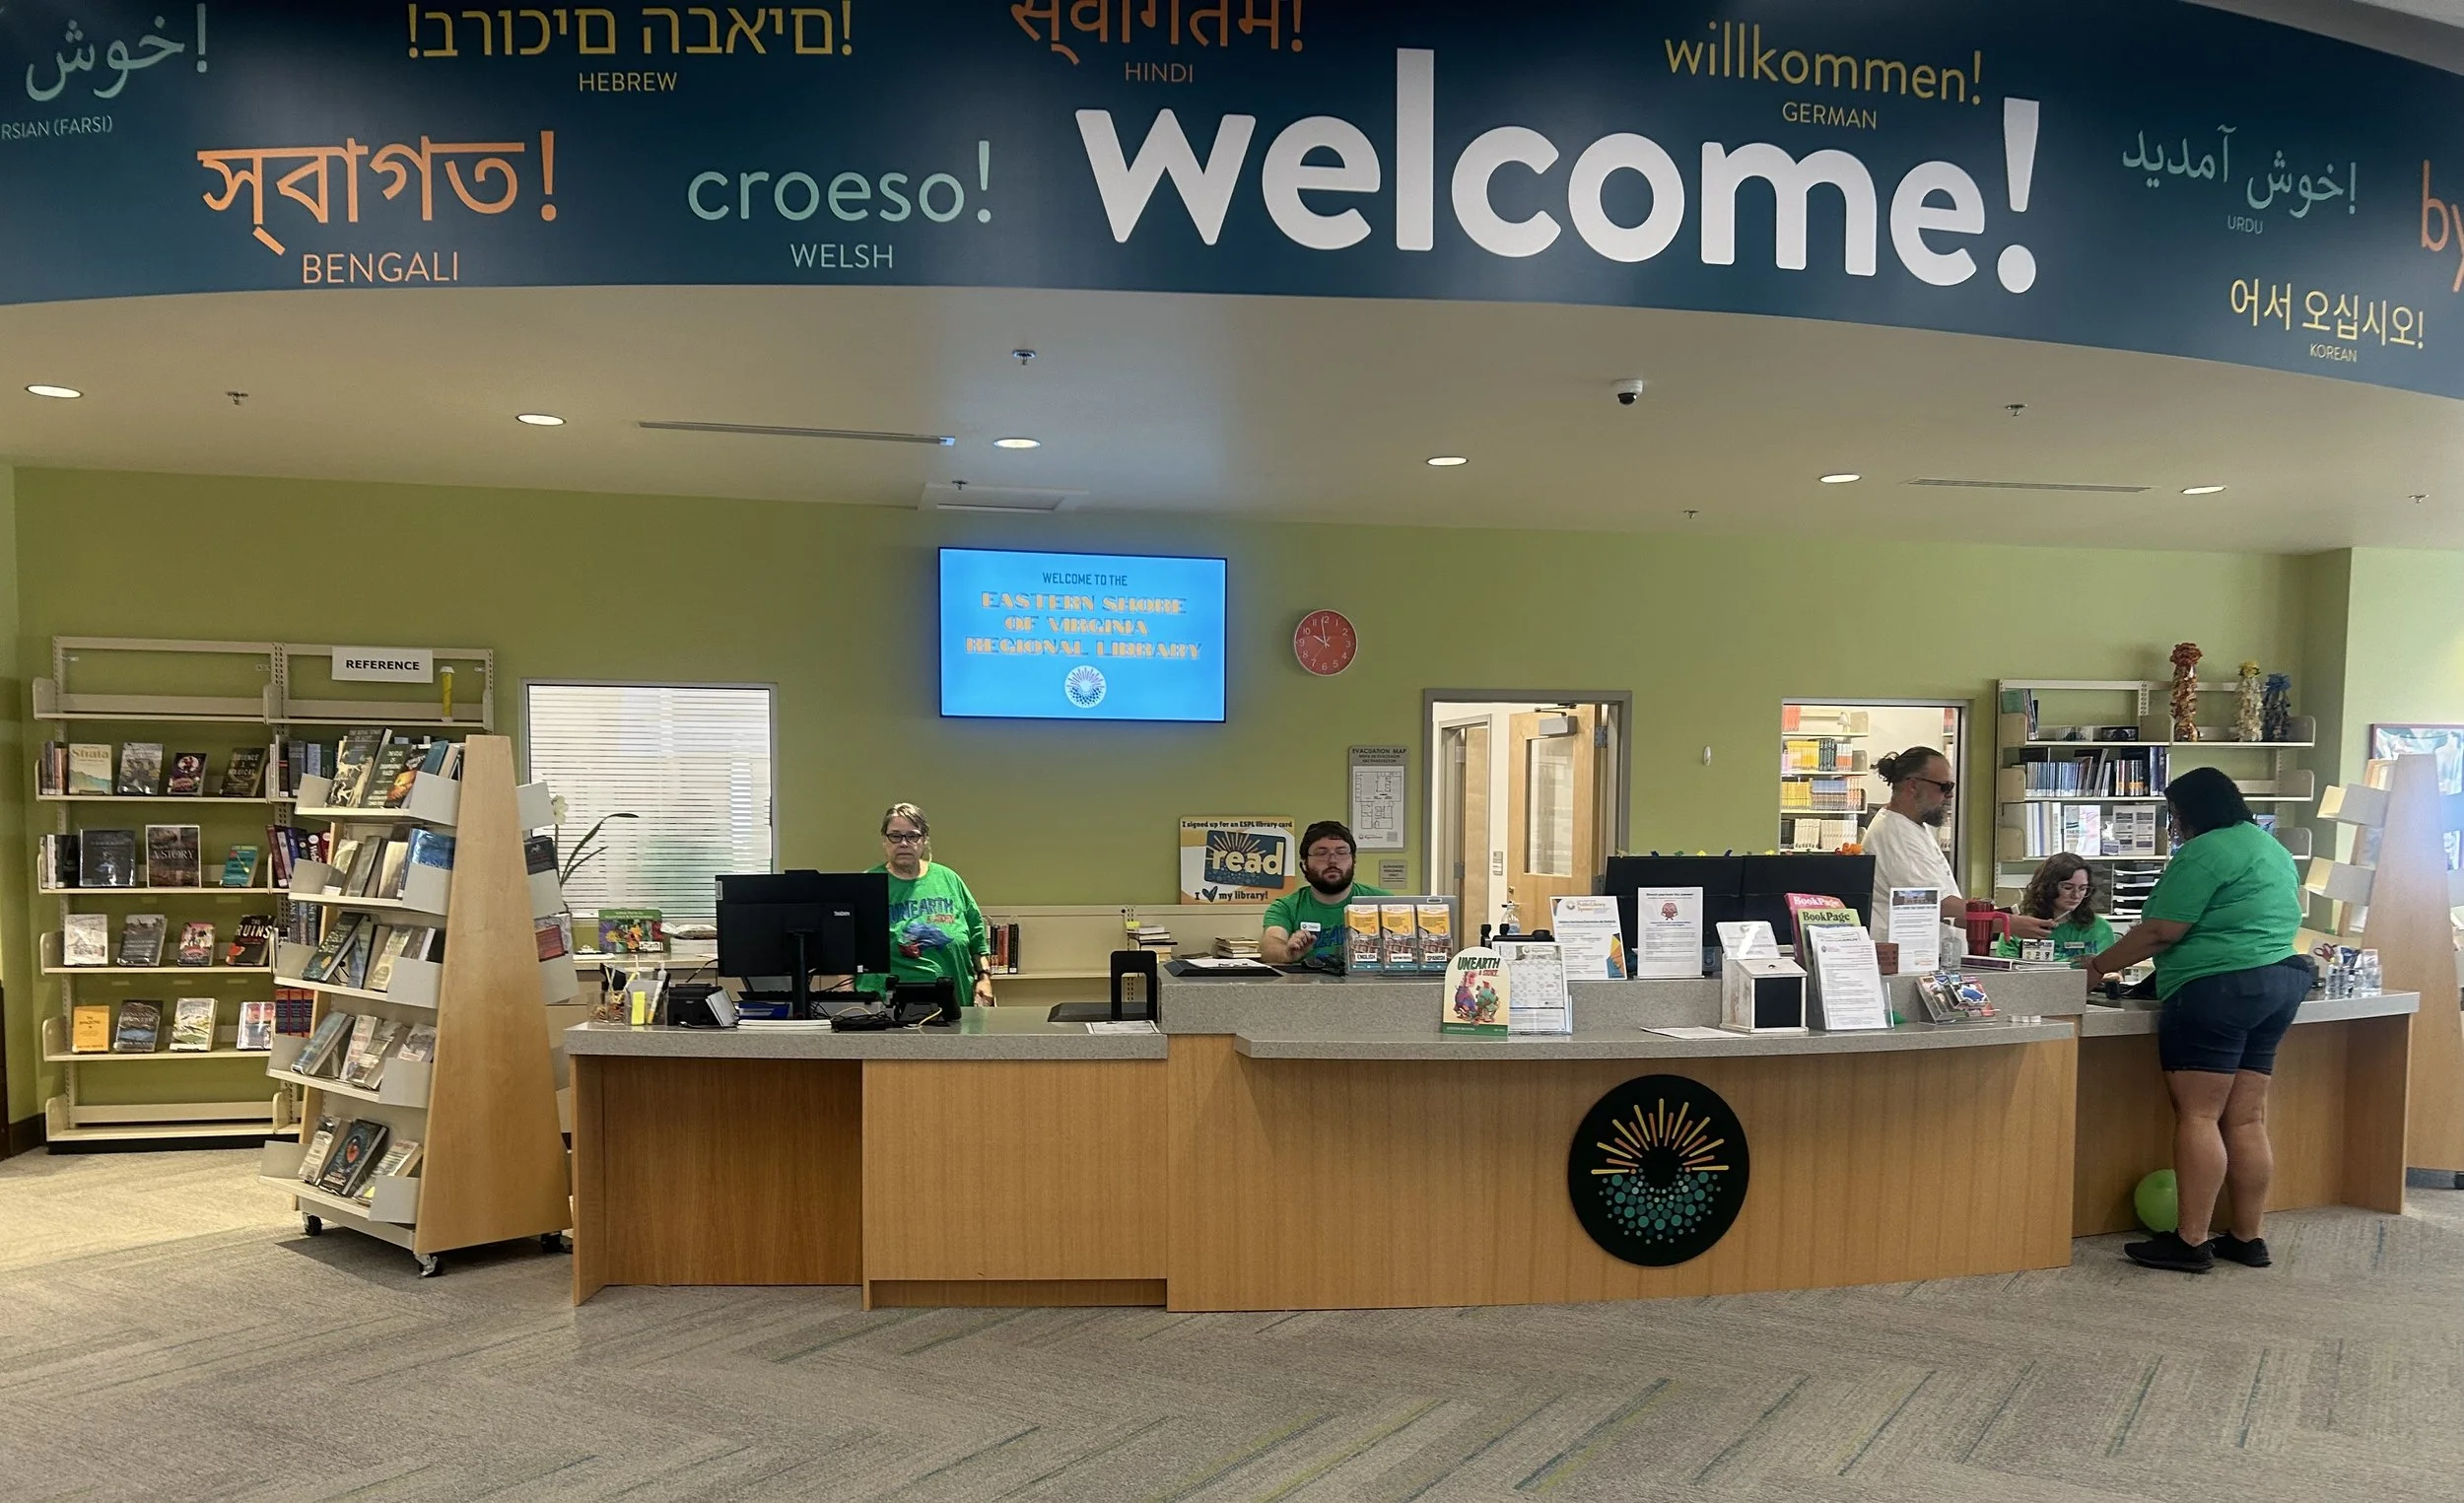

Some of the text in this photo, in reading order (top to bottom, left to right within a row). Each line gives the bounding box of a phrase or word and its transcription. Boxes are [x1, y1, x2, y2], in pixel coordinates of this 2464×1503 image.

[1125, 61, 1194, 83] HINDI
[1665, 21, 1982, 104] willkommen!
[579, 71, 678, 93] HEBREW
[53, 114, 113, 138] (FARSI)
[1782, 102, 1878, 129] GERMAN
[688, 140, 992, 223] croeso!
[1074, 47, 2040, 294] welcome!
[2227, 214, 2264, 235] URDU
[790, 243, 893, 269] WELSH
[302, 251, 458, 284] BENGALI
[2230, 278, 2425, 350] 어서 오십시오!
[2309, 343, 2358, 363] KOREAN
[1042, 572, 1128, 586] WELCOME TO THE
[982, 591, 1187, 614] EASTERN SHORE
[1003, 615, 1148, 635] OF VIRGINIA
[966, 637, 1201, 659] REGIONAL LIBRARY
[346, 659, 420, 670] REFERENCE
[1212, 842, 1284, 875] read
[1219, 892, 1233, 901] my
[1234, 891, 1268, 901] library!
[1794, 896, 1841, 908] BookPage
[1803, 912, 1851, 923] BookPage
[1457, 957, 1501, 971] UNEARTH
